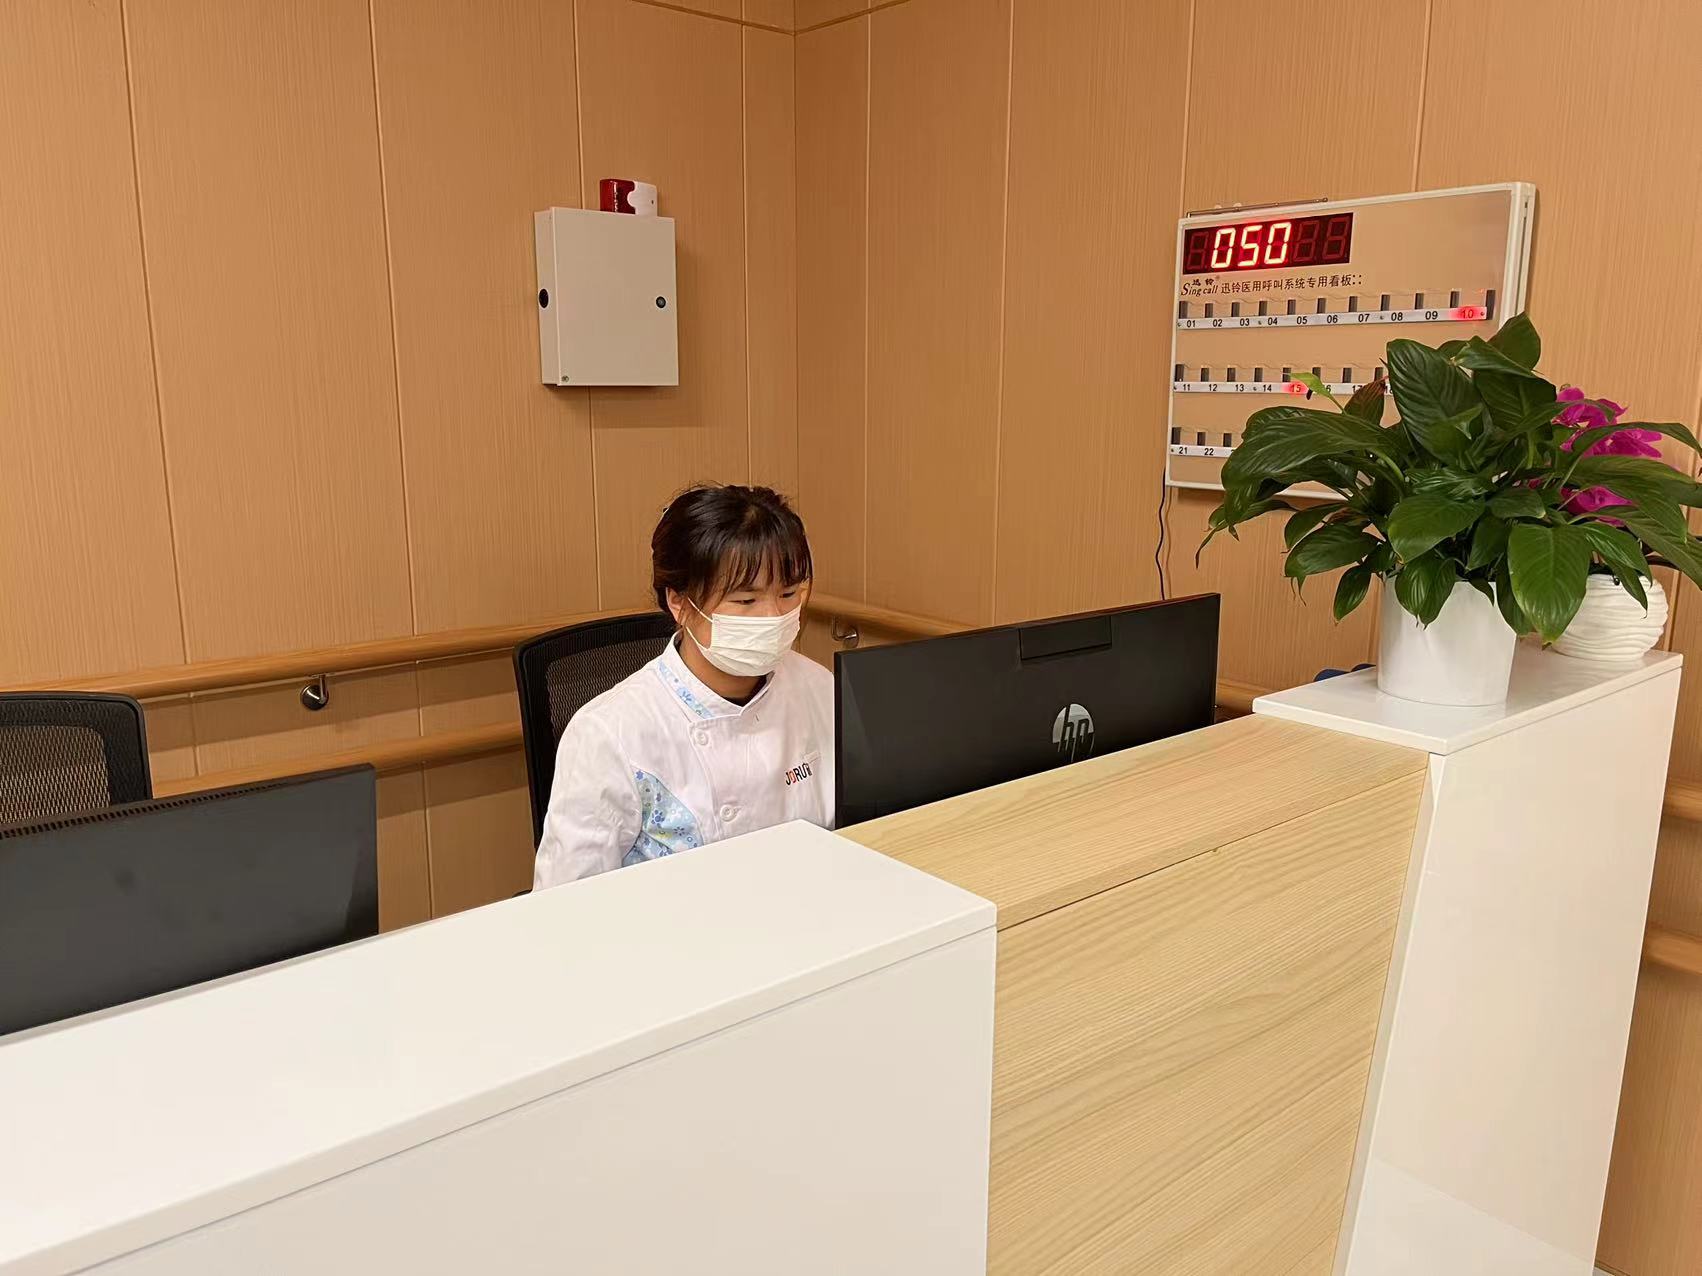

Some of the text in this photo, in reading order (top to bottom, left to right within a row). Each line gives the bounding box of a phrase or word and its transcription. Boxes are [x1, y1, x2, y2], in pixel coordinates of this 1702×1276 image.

[1210, 222, 1292, 269] 050
[1186, 309, 1474, 328] 01 02 03 04 05 06 07 08 09 10
[1182, 383, 1191, 391] 11
[1208, 383, 1218, 392] 12
[1235, 383, 1245, 392] 13
[1262, 384, 1272, 392] 14
[1178, 446, 1215, 456] 21 22
